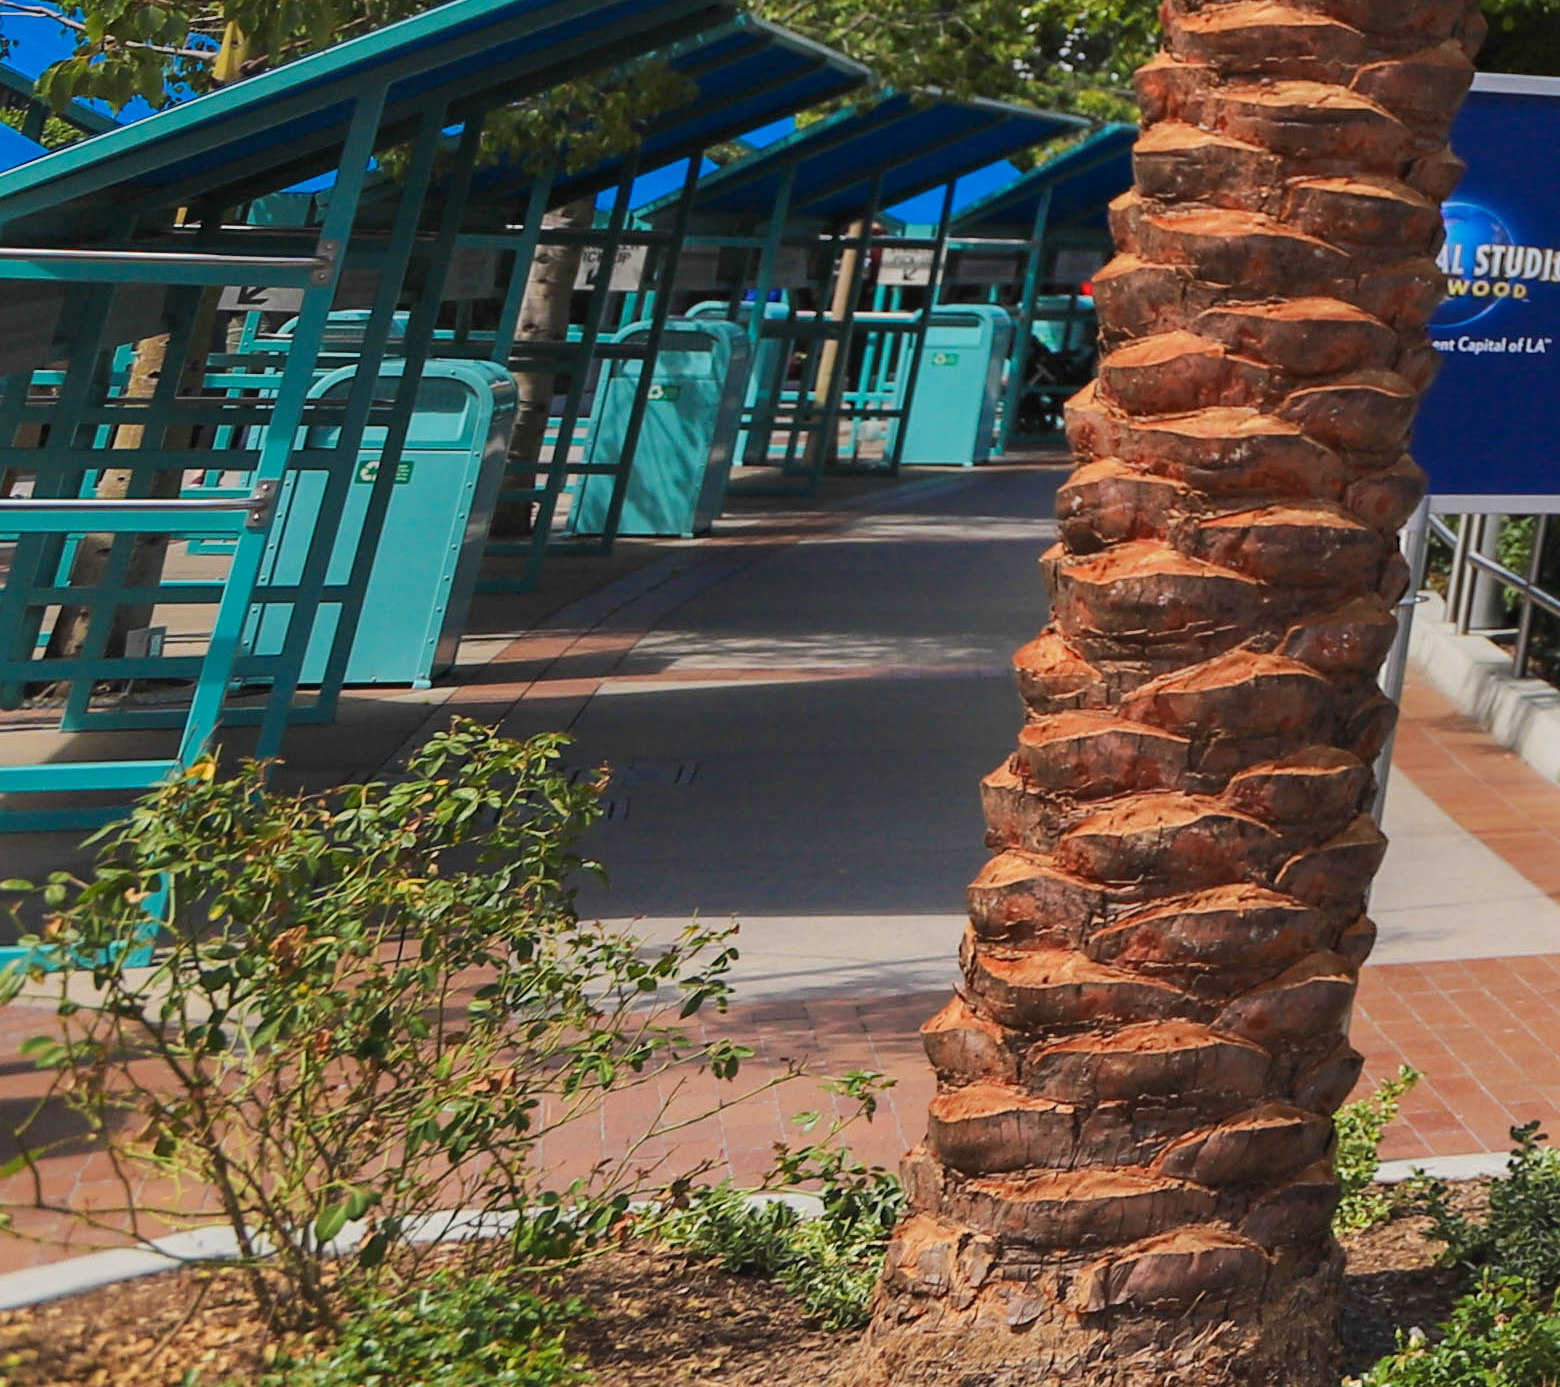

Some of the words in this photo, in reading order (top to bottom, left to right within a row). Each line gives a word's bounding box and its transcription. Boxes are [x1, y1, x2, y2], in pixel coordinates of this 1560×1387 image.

[1435, 243, 1465, 275] AL
[1447, 279, 1528, 299] WOOD
[1432, 338, 1455, 352] ent
[1457, 336, 1507, 355] Capital
[1507, 337, 1526, 353] of
